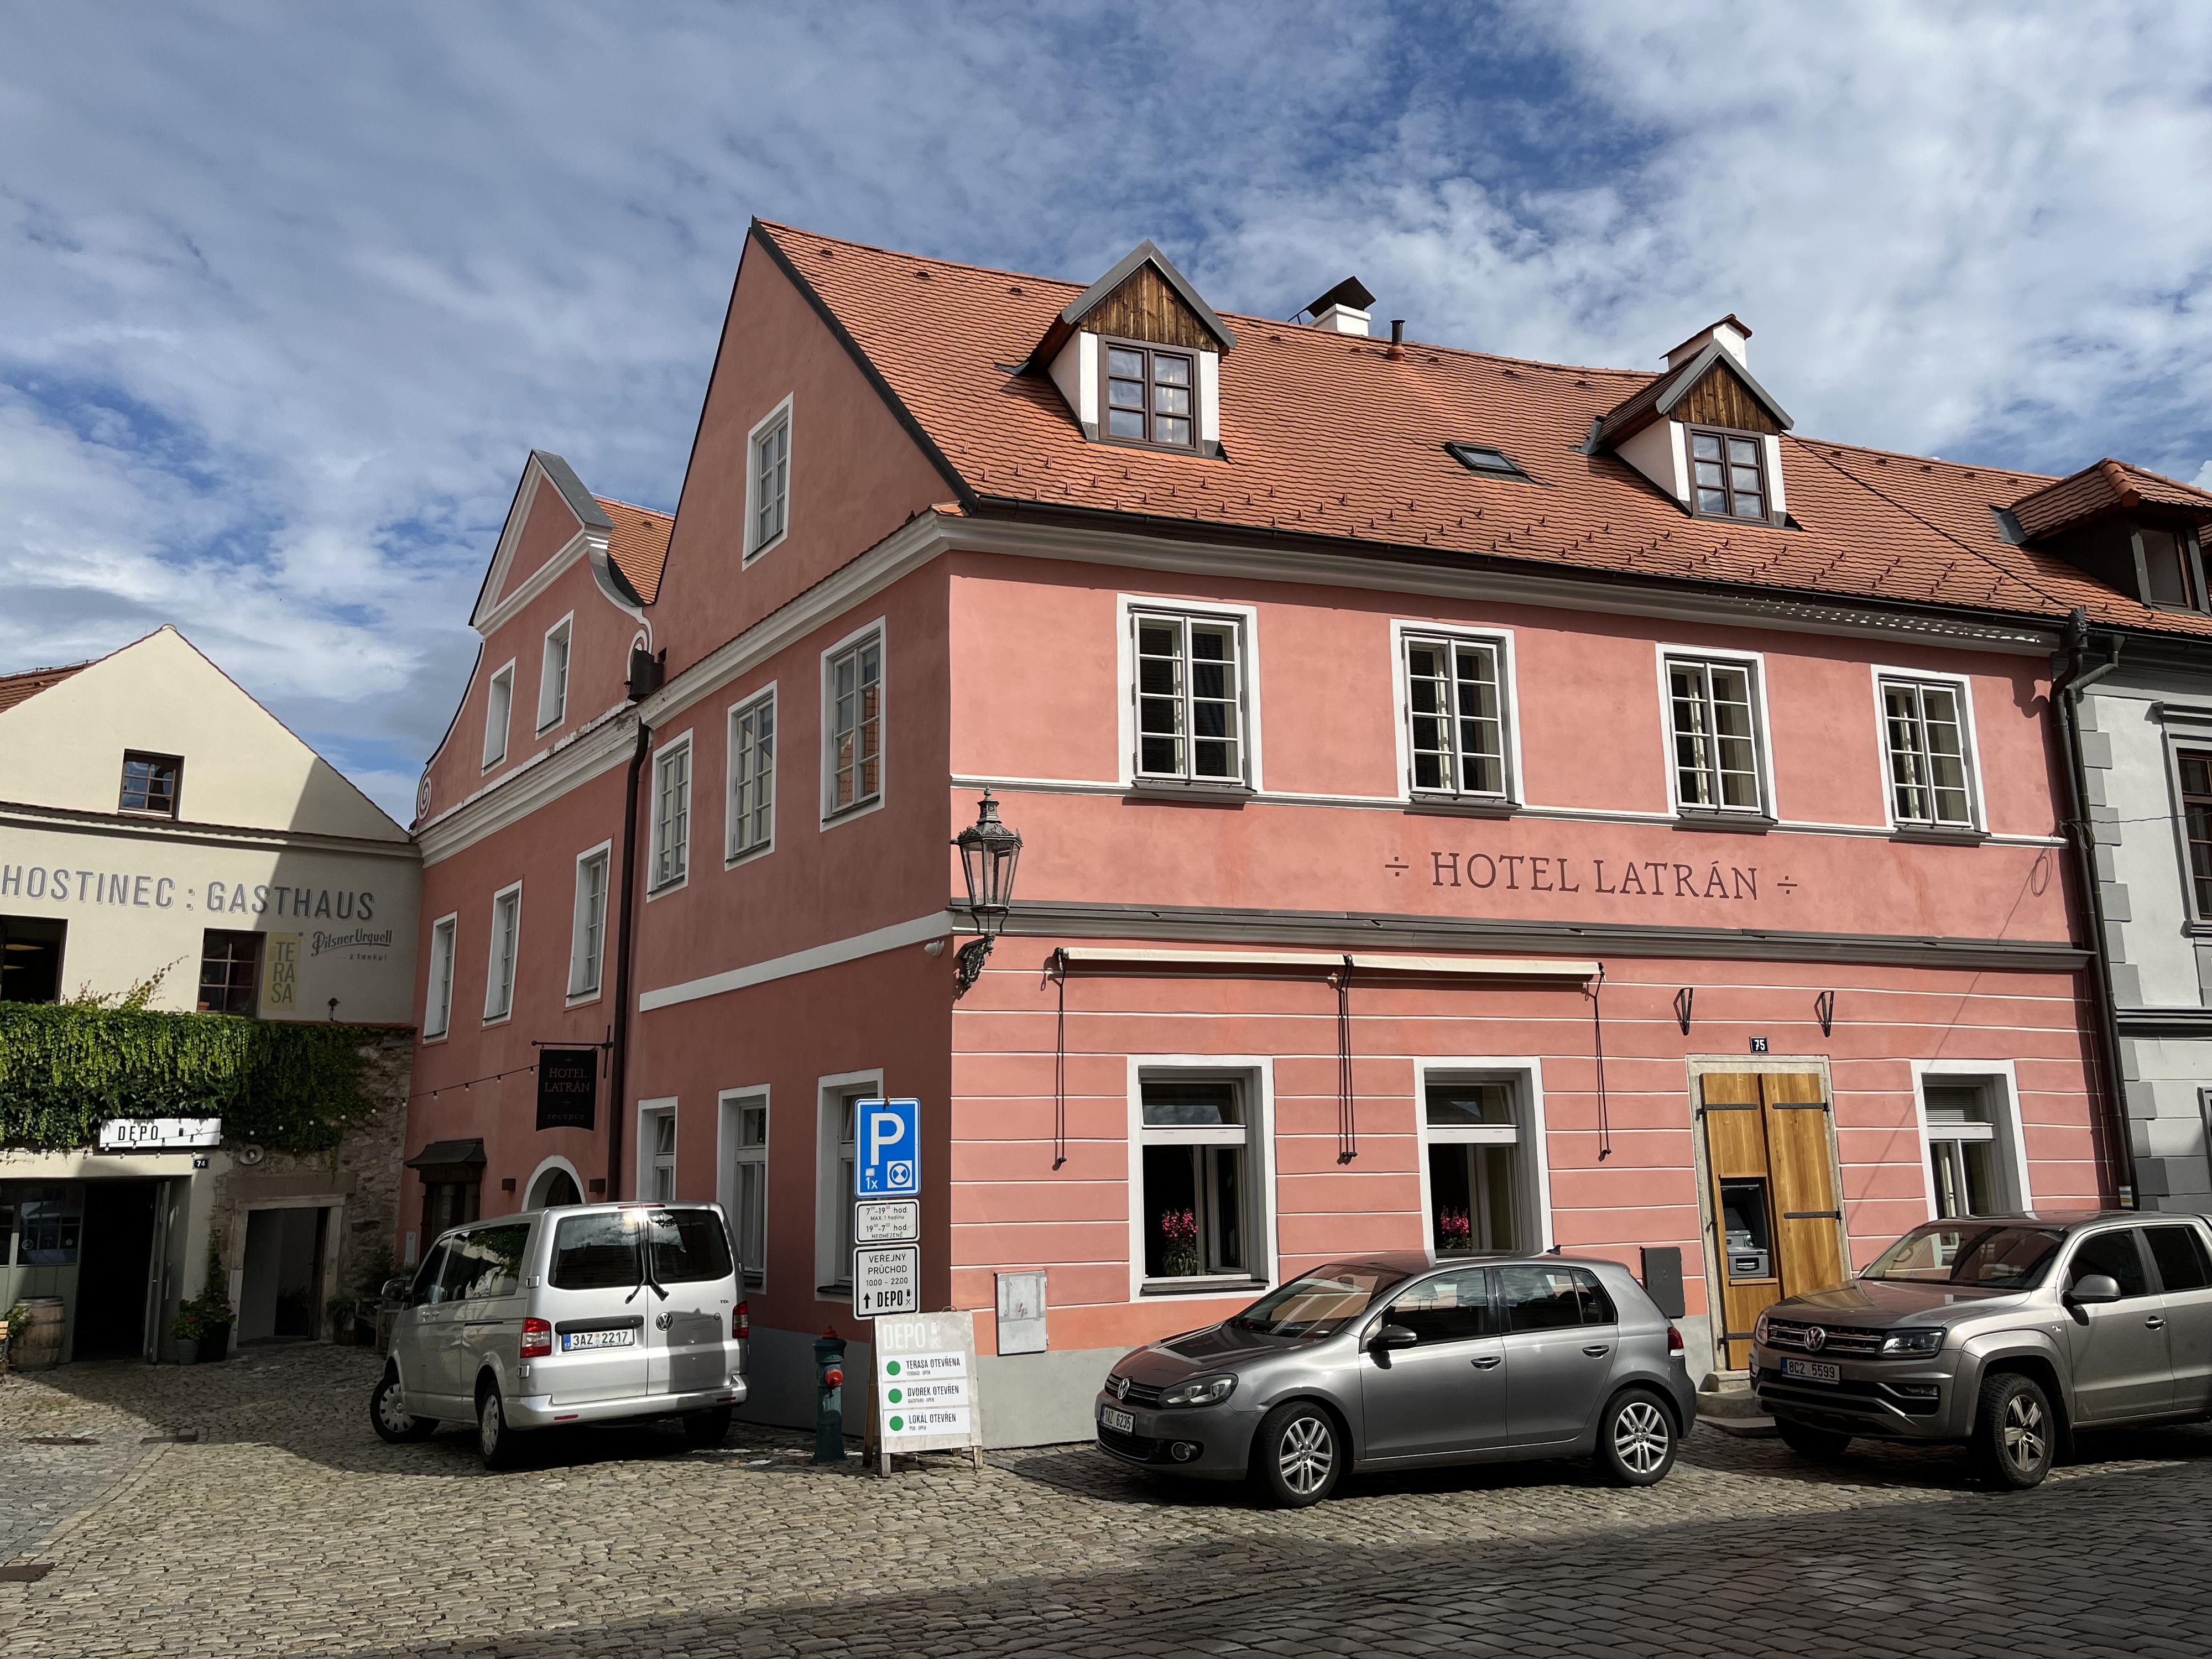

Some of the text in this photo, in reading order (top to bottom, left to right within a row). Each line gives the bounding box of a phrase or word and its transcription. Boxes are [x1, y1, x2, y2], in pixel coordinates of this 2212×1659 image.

[1431, 852, 1757, 900] HOTEL LATRÁN
[2, 864, 175, 910] HOSTINEC
[207, 881, 375, 921] GASTHAUS
[311, 928, 393, 957] Pilsner Urquell
[276, 942, 295, 962] TE
[273, 962, 295, 983] RA
[271, 983, 293, 1004] SA
[1754, 1039, 1765, 1051] 75
[549, 1068, 587, 1078] HOTEL
[544, 1081, 591, 1092] LATRÁN
[118, 1126, 159, 1141] DEPO
[871, 1113, 905, 1166] P
[865, 1177, 878, 1190] 1x
[869, 1252, 906, 1263] VEŘEJNÝ
[868, 1264, 907, 1275] PRŮCHOD
[877, 1290, 903, 1307] DEPO
[573, 1334, 593, 1345] 3AZ
[602, 1332, 628, 1343] 2217
[883, 1323, 926, 1349] DEPO
[906, 1356, 961, 1369] TERASA OTEVŘENA
[1789, 1361, 1805, 1374] 8C2
[1812, 1364, 1835, 1378] 5599
[907, 1384, 959, 1397] DVOREK OTEVŘEN
[909, 1411, 956, 1424] LOKÁL OTEVŘEN
[1117, 1413, 1131, 1430] 6235
